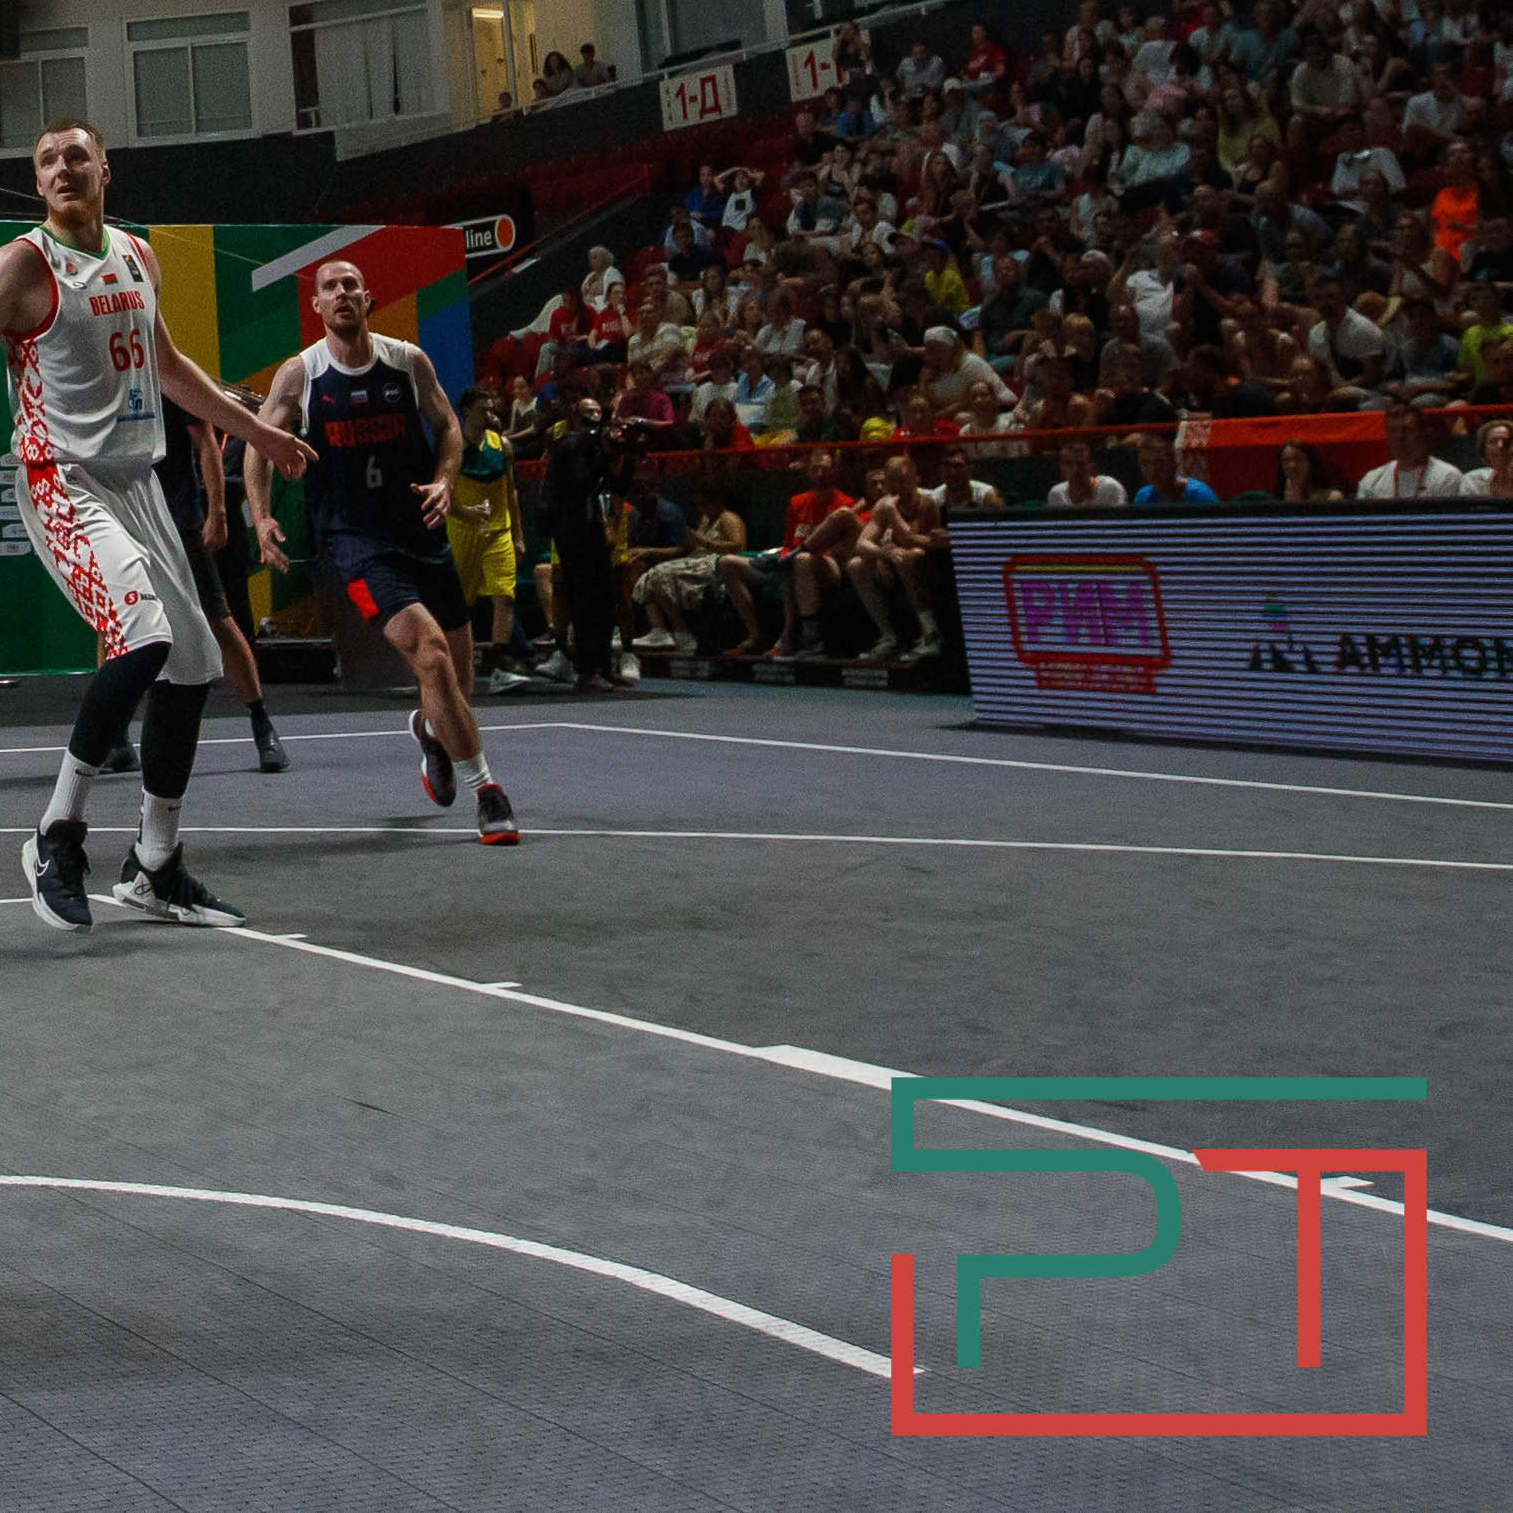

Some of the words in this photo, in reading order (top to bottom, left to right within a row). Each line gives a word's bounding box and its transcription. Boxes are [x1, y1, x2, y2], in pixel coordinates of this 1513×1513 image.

[804, 50, 843, 90] 1-
[89, 290, 145, 317] BELARUS
[109, 327, 145, 372] 66
[365, 454, 383, 488] 6
